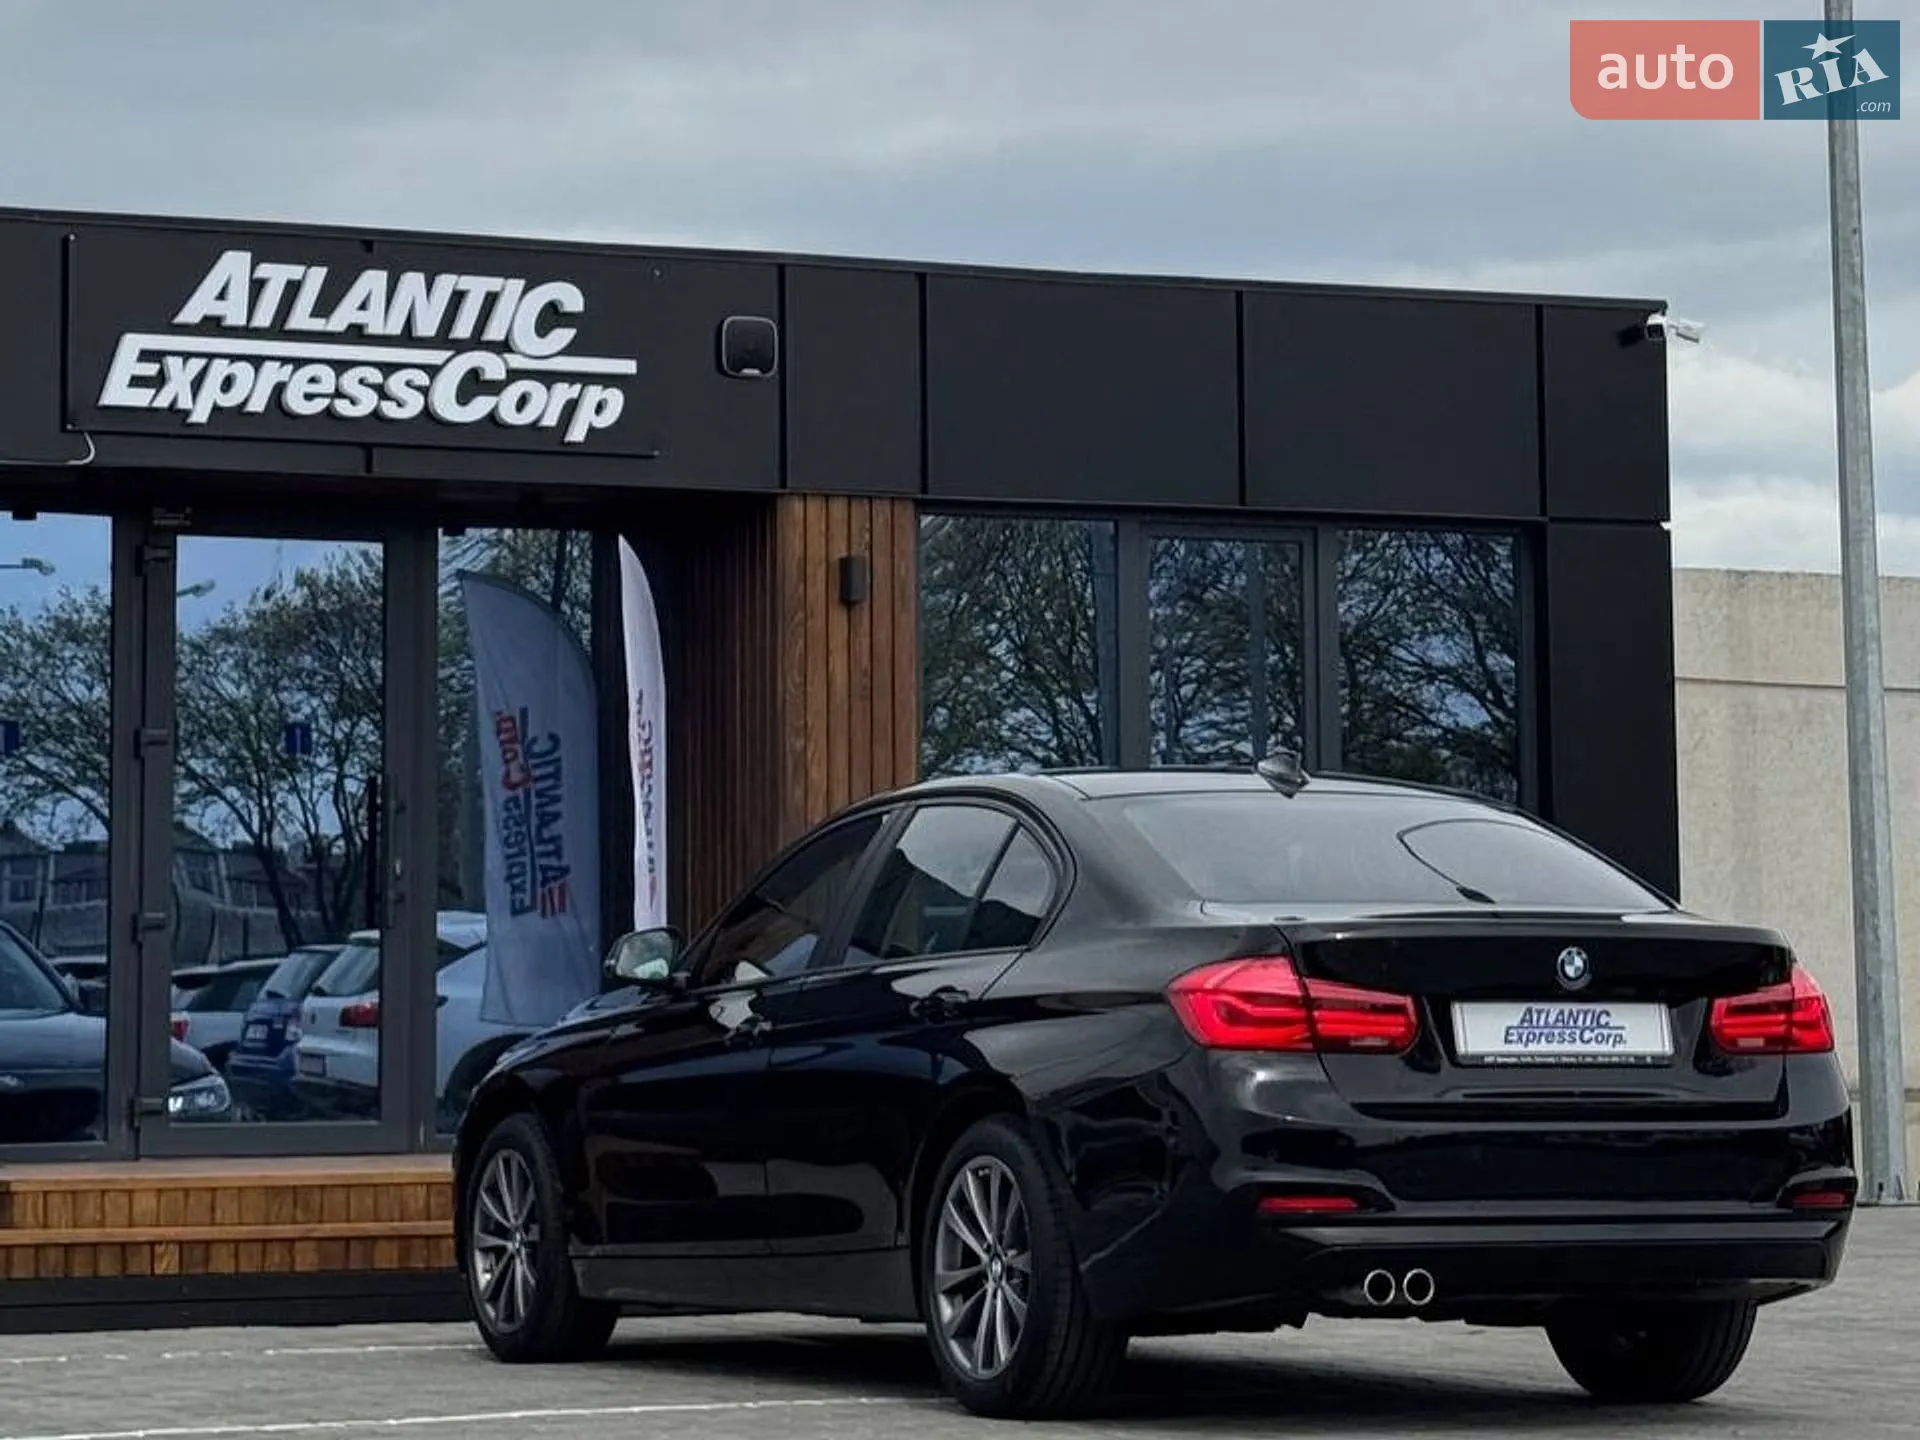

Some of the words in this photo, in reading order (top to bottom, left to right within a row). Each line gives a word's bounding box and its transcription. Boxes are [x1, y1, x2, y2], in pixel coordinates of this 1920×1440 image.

[172, 250, 585, 357] ATLANTIC
[98, 334, 625, 443] ExpressCorp
[1504, 1027, 1627, 1047] ExpressCorp.
[1520, 1006, 1611, 1026] ATLANTIC
